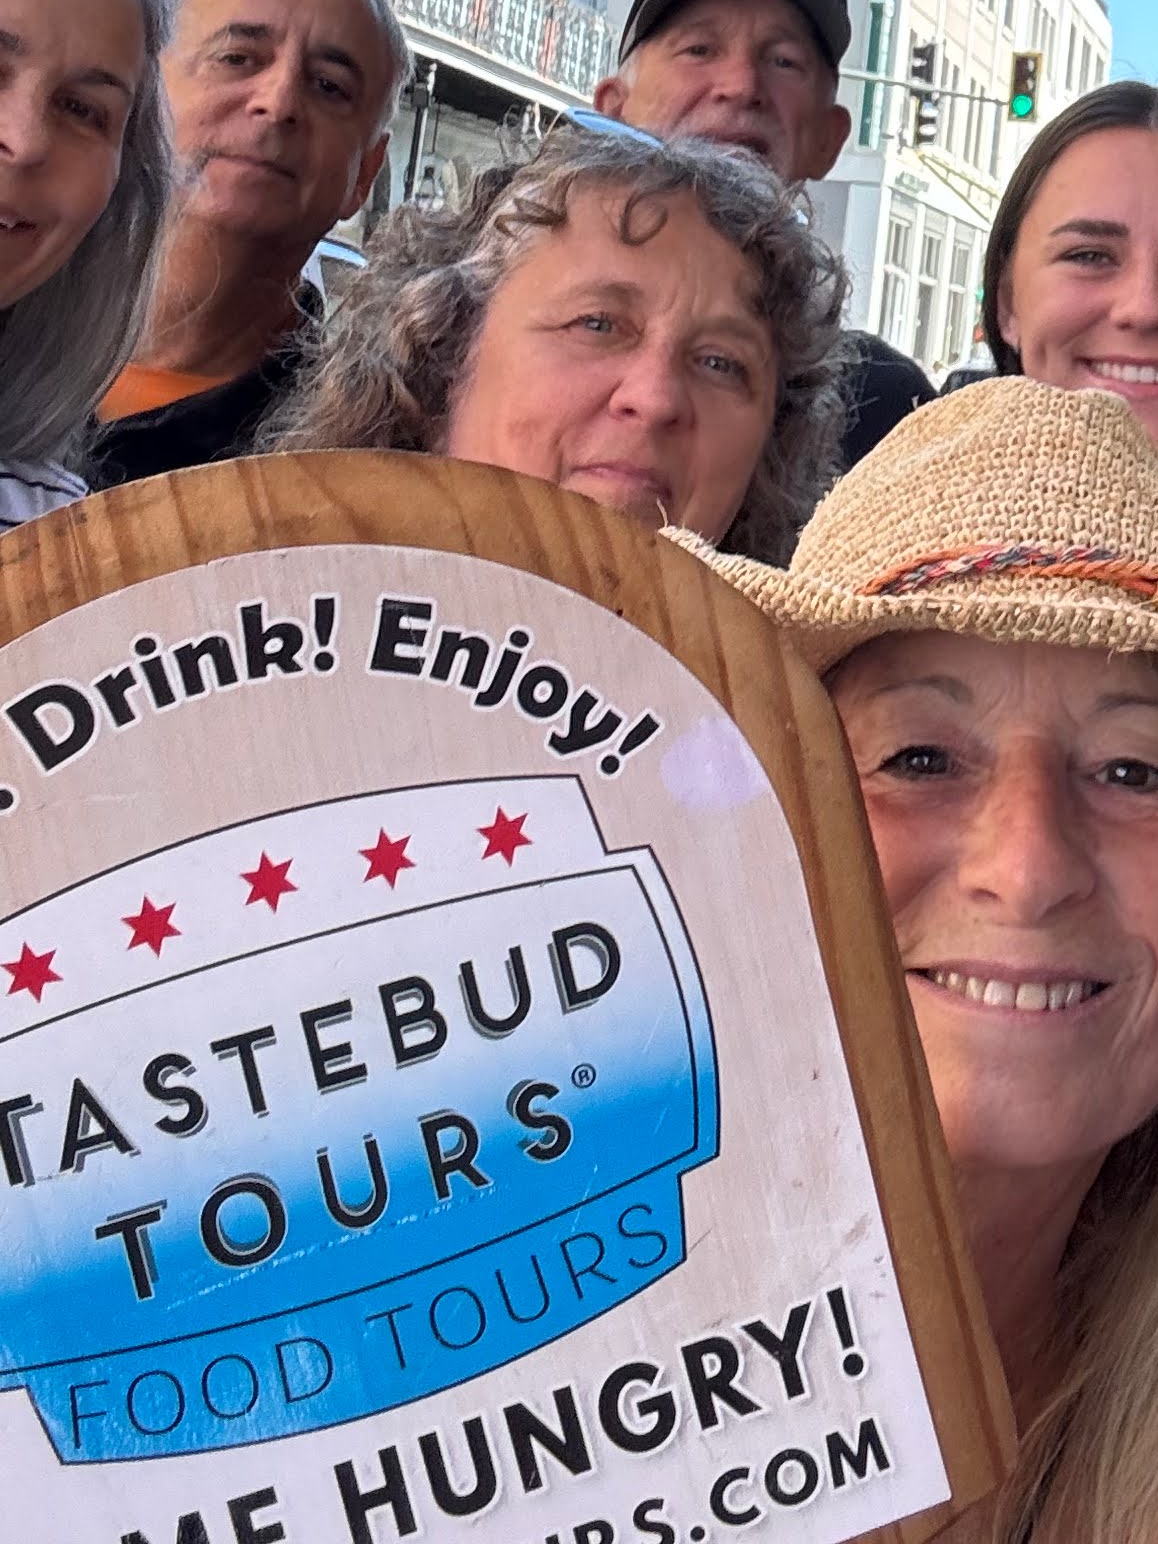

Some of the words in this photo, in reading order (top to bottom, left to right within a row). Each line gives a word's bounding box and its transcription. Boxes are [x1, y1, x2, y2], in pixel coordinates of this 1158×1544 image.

[4, 598, 336, 773] Drink!
[369, 598, 661, 774] Enjoy!
[0, 922, 622, 1188] TASTEBUD
[69, 1336, 334, 1449] FOOD
[366, 1202, 669, 1372] TOURS
[334, 1287, 867, 1544] HUNGRY!
